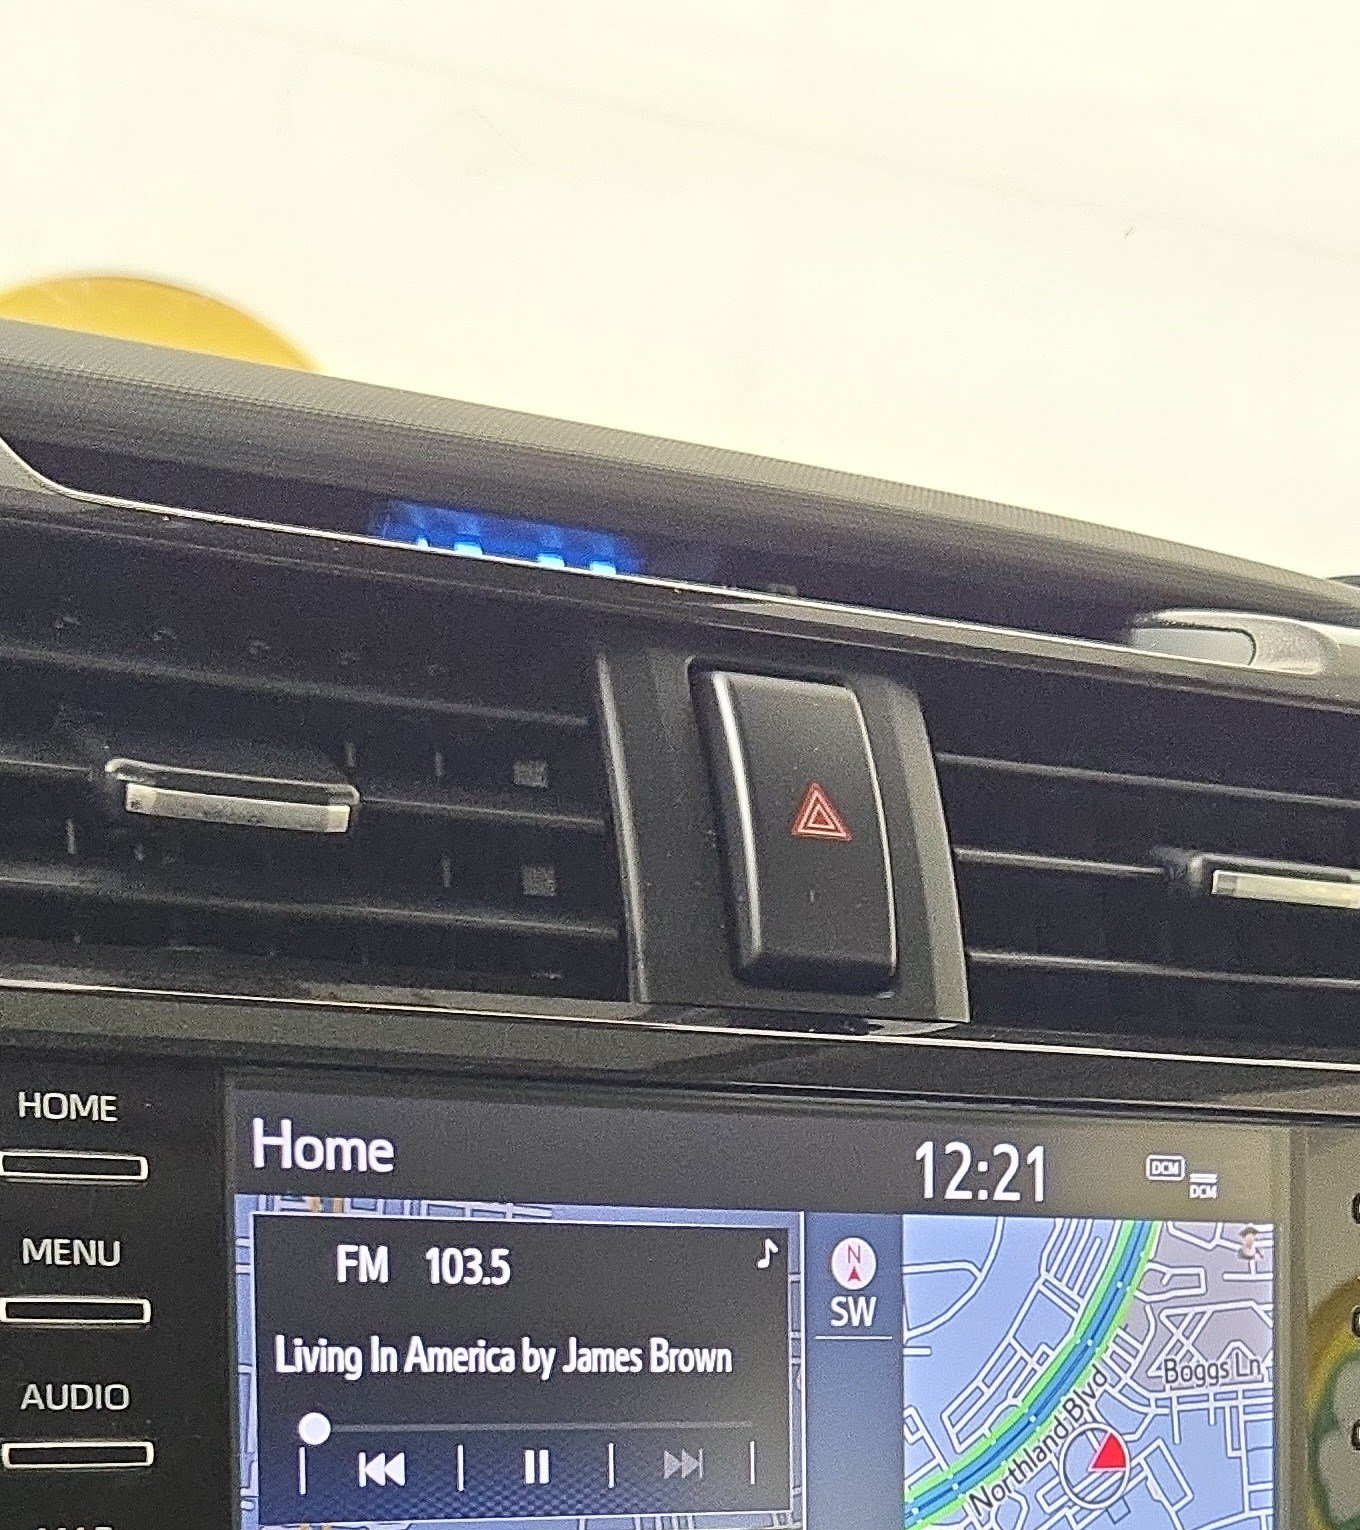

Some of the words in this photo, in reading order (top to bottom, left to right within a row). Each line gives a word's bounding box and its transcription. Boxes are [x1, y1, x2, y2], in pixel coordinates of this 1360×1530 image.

[17, 1091, 119, 1122] HOME
[252, 1117, 395, 1173] Home
[915, 1140, 1046, 1202] 12:21
[1151, 1160, 1181, 1177] DCM
[1189, 1184, 1218, 1200] DCM
[22, 1238, 121, 1267] MENU
[336, 1244, 389, 1284] FM
[425, 1246, 511, 1286] 103.5
[830, 1296, 877, 1328] SW
[275, 1335, 362, 1381] Living
[371, 1336, 398, 1374] In
[404, 1335, 515, 1374] America
[522, 1337, 556, 1381] by
[562, 1337, 642, 1374] James
[650, 1338, 733, 1374] Brown
[1163, 1358, 1229, 1386] Boggs
[1235, 1355, 1262, 1378] Ln
[20, 1383, 130, 1411] AUDIO
[969, 1415, 1069, 1516] Northland
[1063, 1364, 1107, 1420] Blvd
